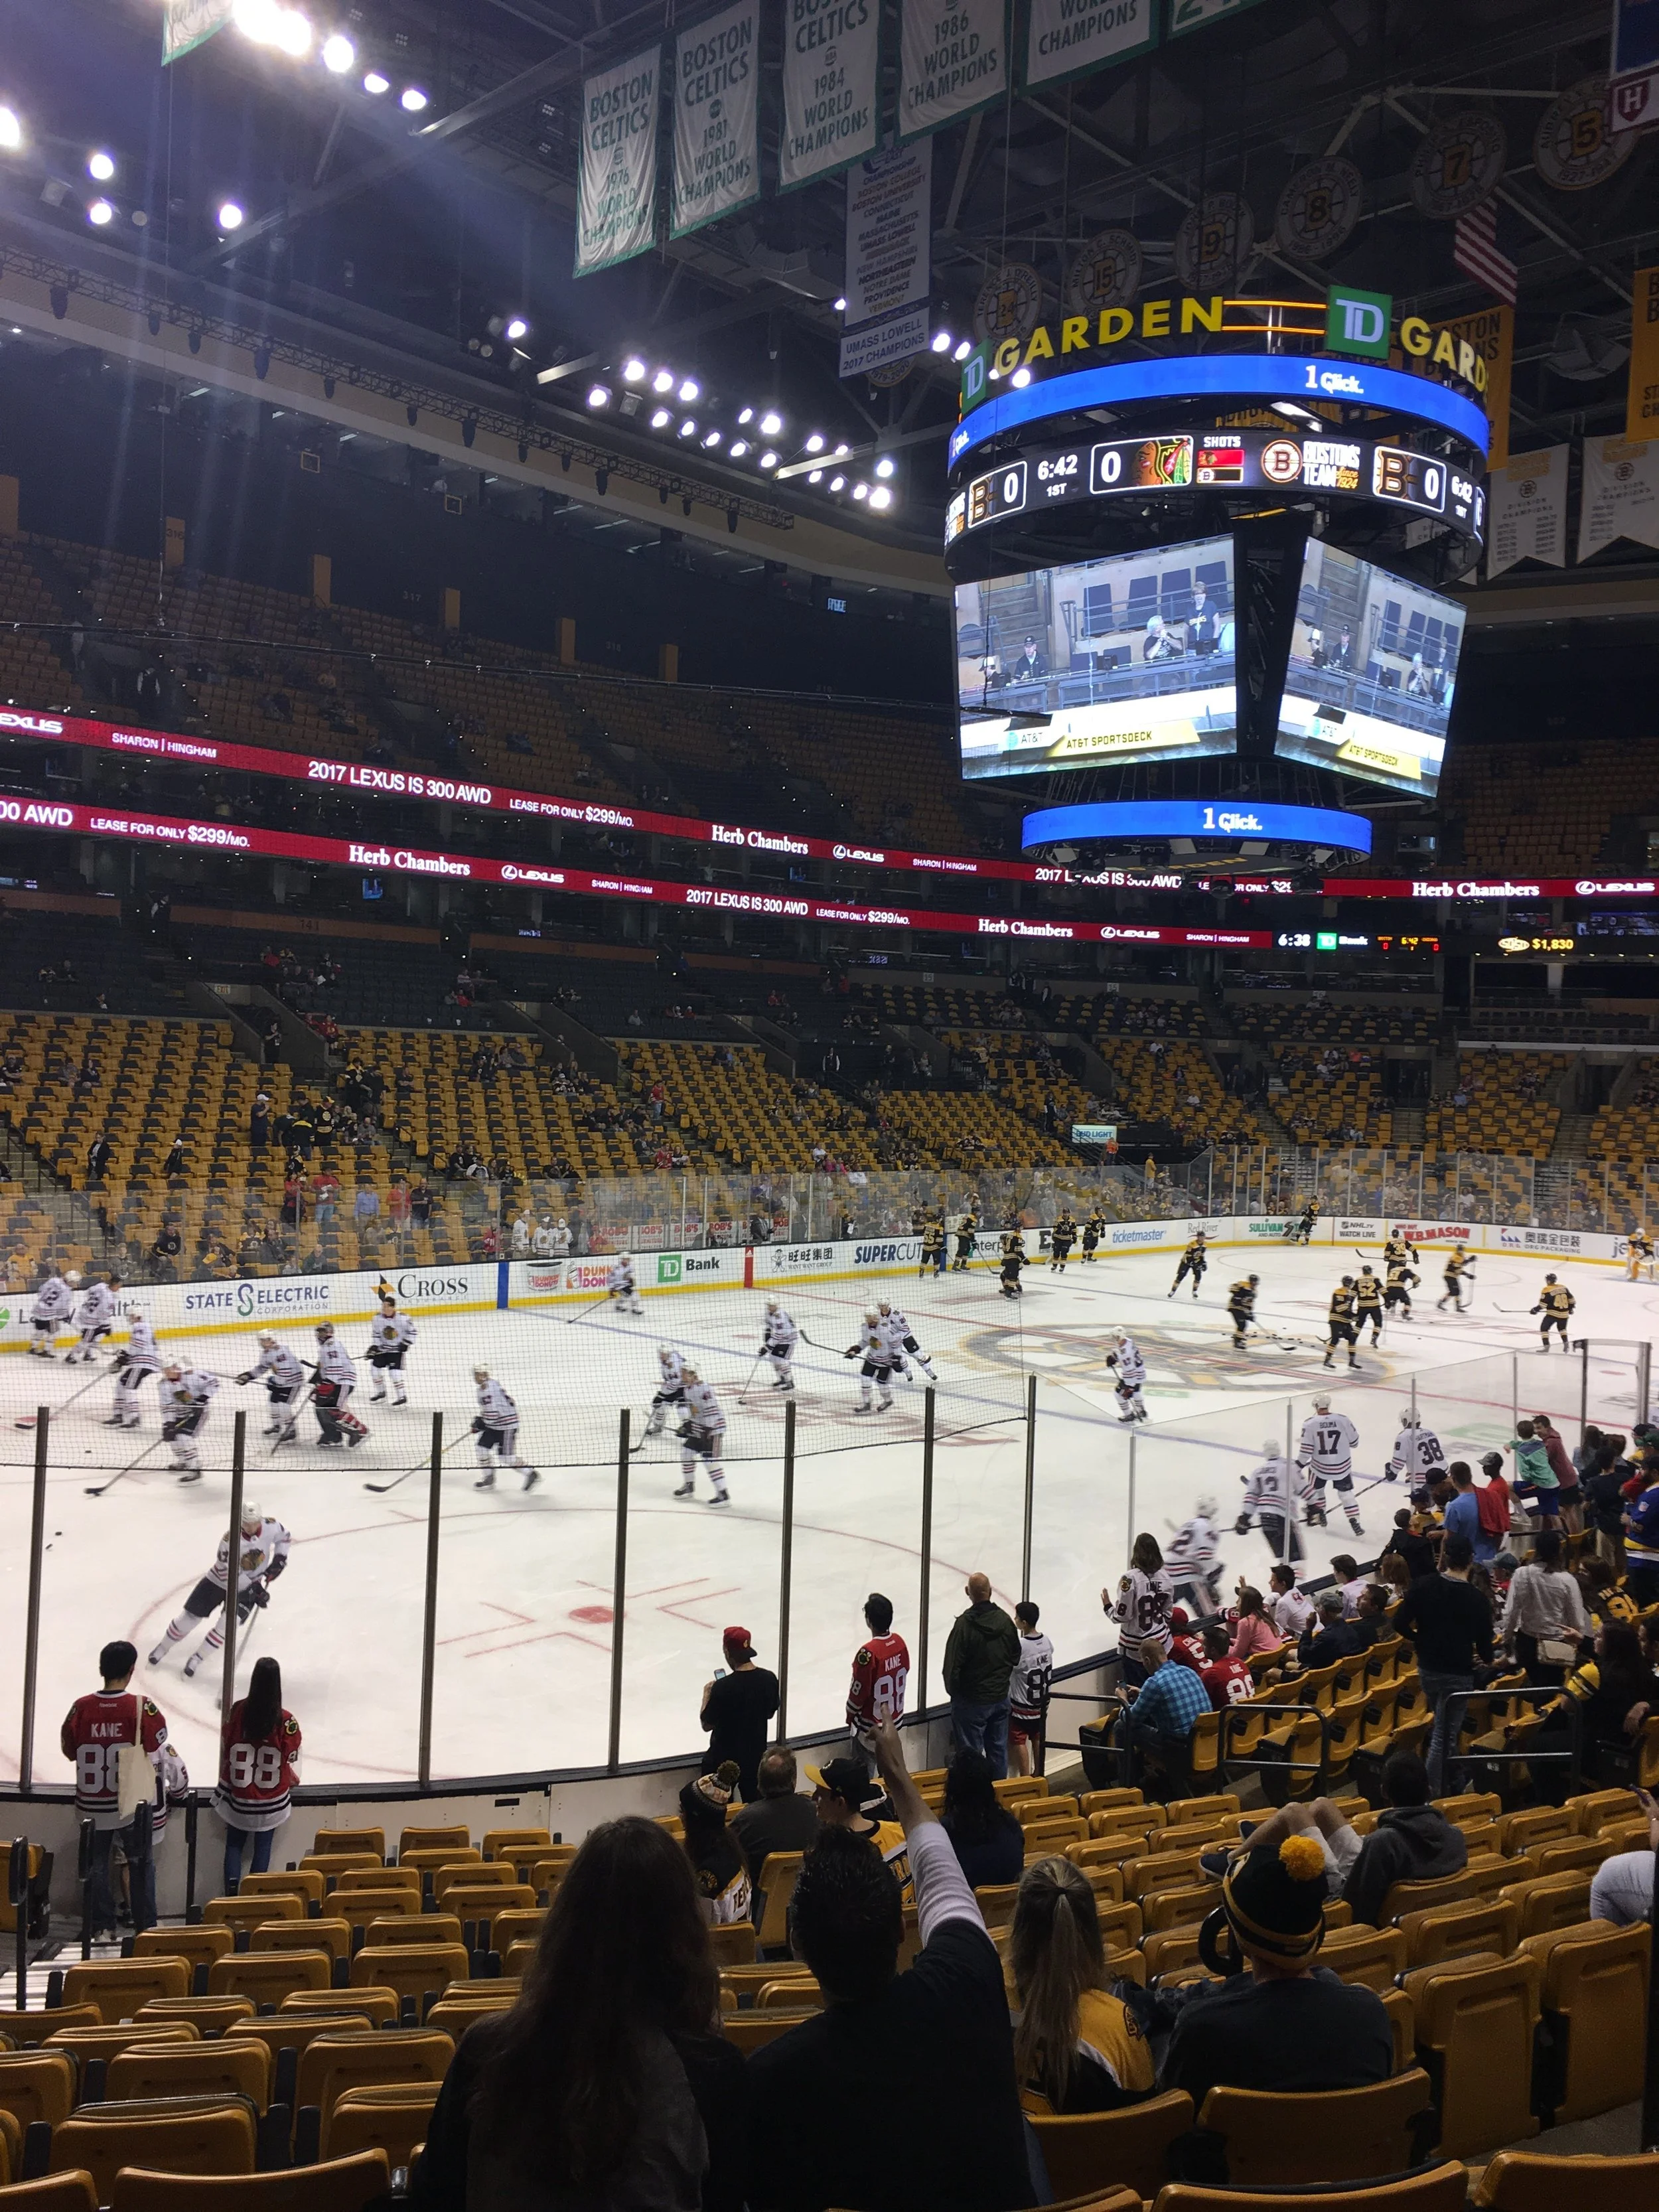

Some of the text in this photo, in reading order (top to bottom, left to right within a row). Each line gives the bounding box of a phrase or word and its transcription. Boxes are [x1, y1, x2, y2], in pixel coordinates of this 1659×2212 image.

[796, 0, 868, 53] CELTICS
[934, 9, 969, 44] 1986
[1039, 3, 1137, 55] CHAMPIONS
[683, 17, 752, 78] BOSTON
[924, 33, 979, 76] WORLD
[685, 51, 749, 106] CELTICS
[815, 67, 844, 98] 1984
[908, 48, 997, 109] CHAMPIONS
[590, 70, 653, 122] BOSTON
[1626, 86, 1643, 113] H
[804, 90, 852, 128] WORLD
[591, 103, 649, 151] CELTICS
[703, 119, 728, 148] 1981
[788, 107, 868, 159] CHAMPIONS
[694, 140, 736, 174] WORLD
[606, 168, 629, 192] 1976
[680, 158, 751, 205] CHAMPIONS
[597, 188, 636, 218] WORLD
[1309, 196, 1327, 222] 8
[584, 204, 648, 246] CHAMPIONS
[1205, 230, 1220, 255] 9
[863, 277, 887, 294] NOTRE
[1097, 265, 1112, 291] 15
[864, 280, 910, 305] PROVIDENCE
[1336, 299, 1384, 343] TD
[846, 319, 922, 354] UMASS LOWELL
[995, 296, 1223, 377] GARDEN
[843, 332, 925, 370] 2017 CHAMPIONS
[964, 355, 984, 400] TD
[1305, 365, 1318, 388] 1
[1204, 436, 1241, 448] SHOTS
[1038, 455, 1078, 480] 6:42
[1100, 451, 1121, 482] 0
[1303, 441, 1360, 469] BOSTON'S
[1303, 463, 1336, 487] TEAM
[1336, 467, 1359, 479] Since
[1336, 478, 1359, 489] 1924
[1423, 468, 1439, 500] 0
[1004, 473, 1019, 504] 0
[1046, 483, 1067, 496] 1ST
[111, 732, 216, 759] SHARON HINGHAM
[1066, 730, 1153, 749] AT&T SPORTSDECK
[1364, 747, 1400, 767] SPORTSDECK
[308, 761, 492, 805] 2017 LEXUS IS 300 AWD
[24, 804, 73, 826] AWD
[510, 798, 634, 828] LEASE FOR ONLY $299/MO.
[1203, 808, 1215, 829] 1
[90, 818, 250, 847] LEASE FOR ONLY $299/MO.
[711, 825, 808, 855] Herb Chambers
[348, 845, 470, 876] Herb Chambers
[847, 849, 884, 863] LEXUS
[912, 858, 977, 871] SHARON HINGHAM
[518, 869, 564, 884] LEXUS
[591, 879, 653, 895] SHARON HINGHAM
[1035, 867, 1062, 882] 2017
[1112, 872, 1125, 886] IS
[1151, 875, 1182, 889] AWD
[1595, 883, 1655, 893] LEXUS
[1412, 882, 1540, 897] Herb Chambers
[686, 889, 808, 916] 2017 LEXUS IS 300 AWD
[816, 908, 910, 925] LEASE FOR ONLY $299/MO.
[978, 919, 1073, 938] Herb Chambers
[1116, 930, 1160, 939] LEXUS
[1186, 933, 1250, 944] SHARON HINGHAM
[1278, 934, 1311, 946] 6:38
[1320, 934, 1336, 946] TD
[1338, 935, 1368, 946] Bank
[1532, 938, 1574, 952] $1,830
[1092, 1130, 1113, 1139] LIGHT
[1112, 1230, 1164, 1244] ticketmaster
[1202, 1221, 1218, 1232] River
[1248, 1223, 1283, 1232] SULLIVAN
[1541, 1245, 1581, 1254] PACKAGING
[660, 1256, 720, 1278] TD Bank
[186, 1285, 329, 1310] STATE ELECTRIC
[1358, 1282, 1376, 1297] 52
[257, 1301, 328, 1315] CORPORATION
[1317, 1430, 1341, 1455] 17
[1417, 1438, 1445, 1465] 38
[885, 1653, 901, 1672] KANE
[873, 1666, 907, 1721] 88
[91, 1722, 122, 1738] KANE
[229, 1743, 281, 1789] 88
